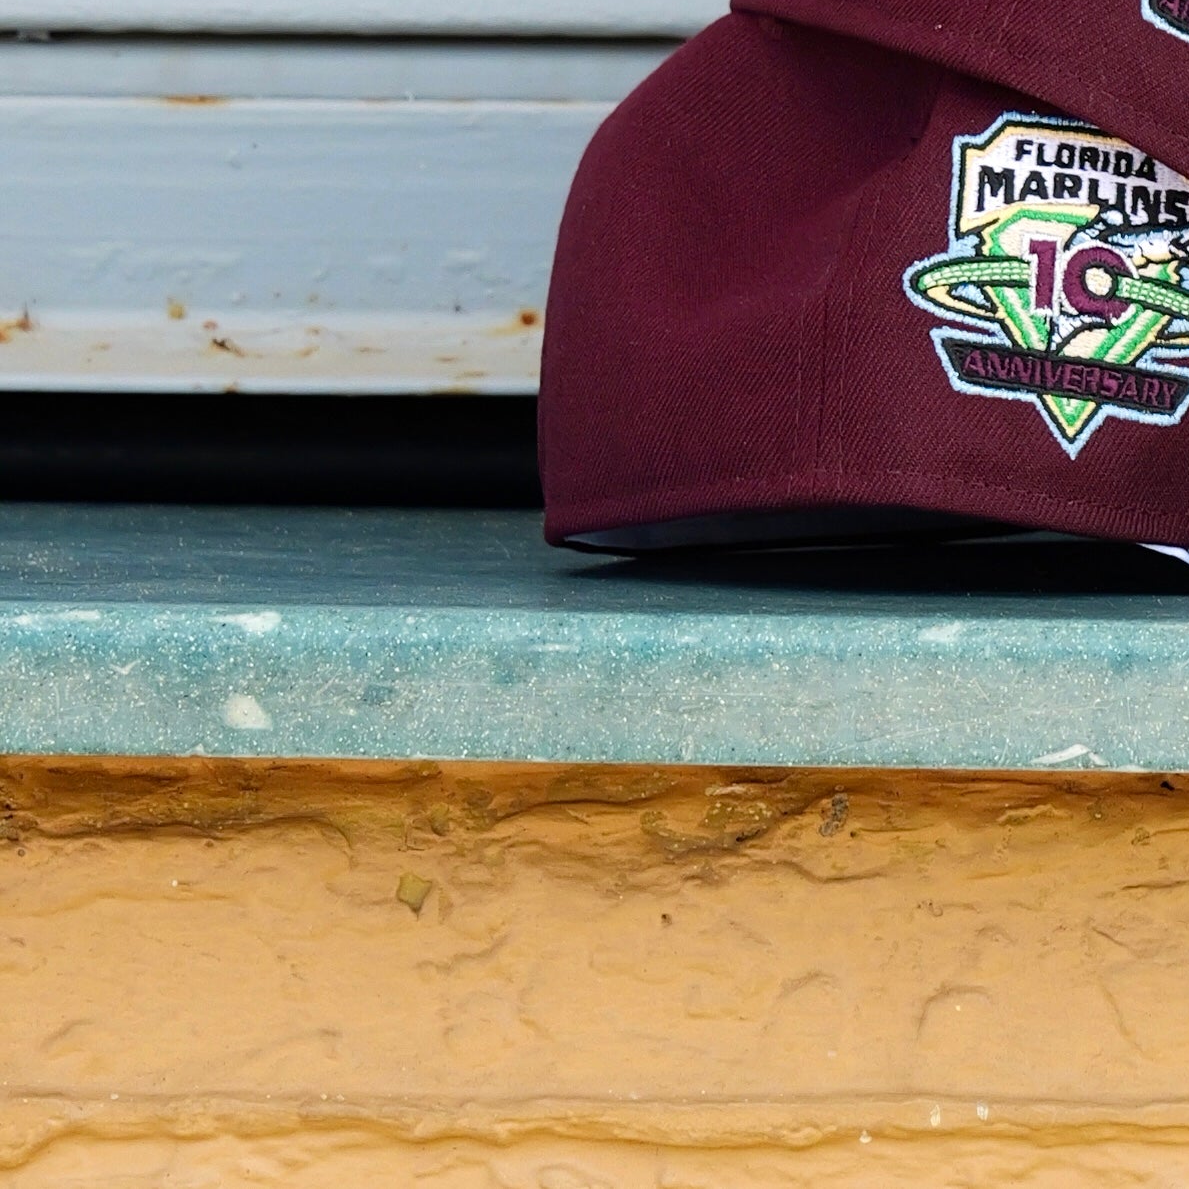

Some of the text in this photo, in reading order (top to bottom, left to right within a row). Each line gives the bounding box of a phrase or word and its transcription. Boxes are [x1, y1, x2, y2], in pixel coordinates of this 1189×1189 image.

[1014, 139, 1158, 183] FLORIDA
[1028, 238, 1136, 322] 10
[962, 349, 1178, 409] ANNIVERSARY
